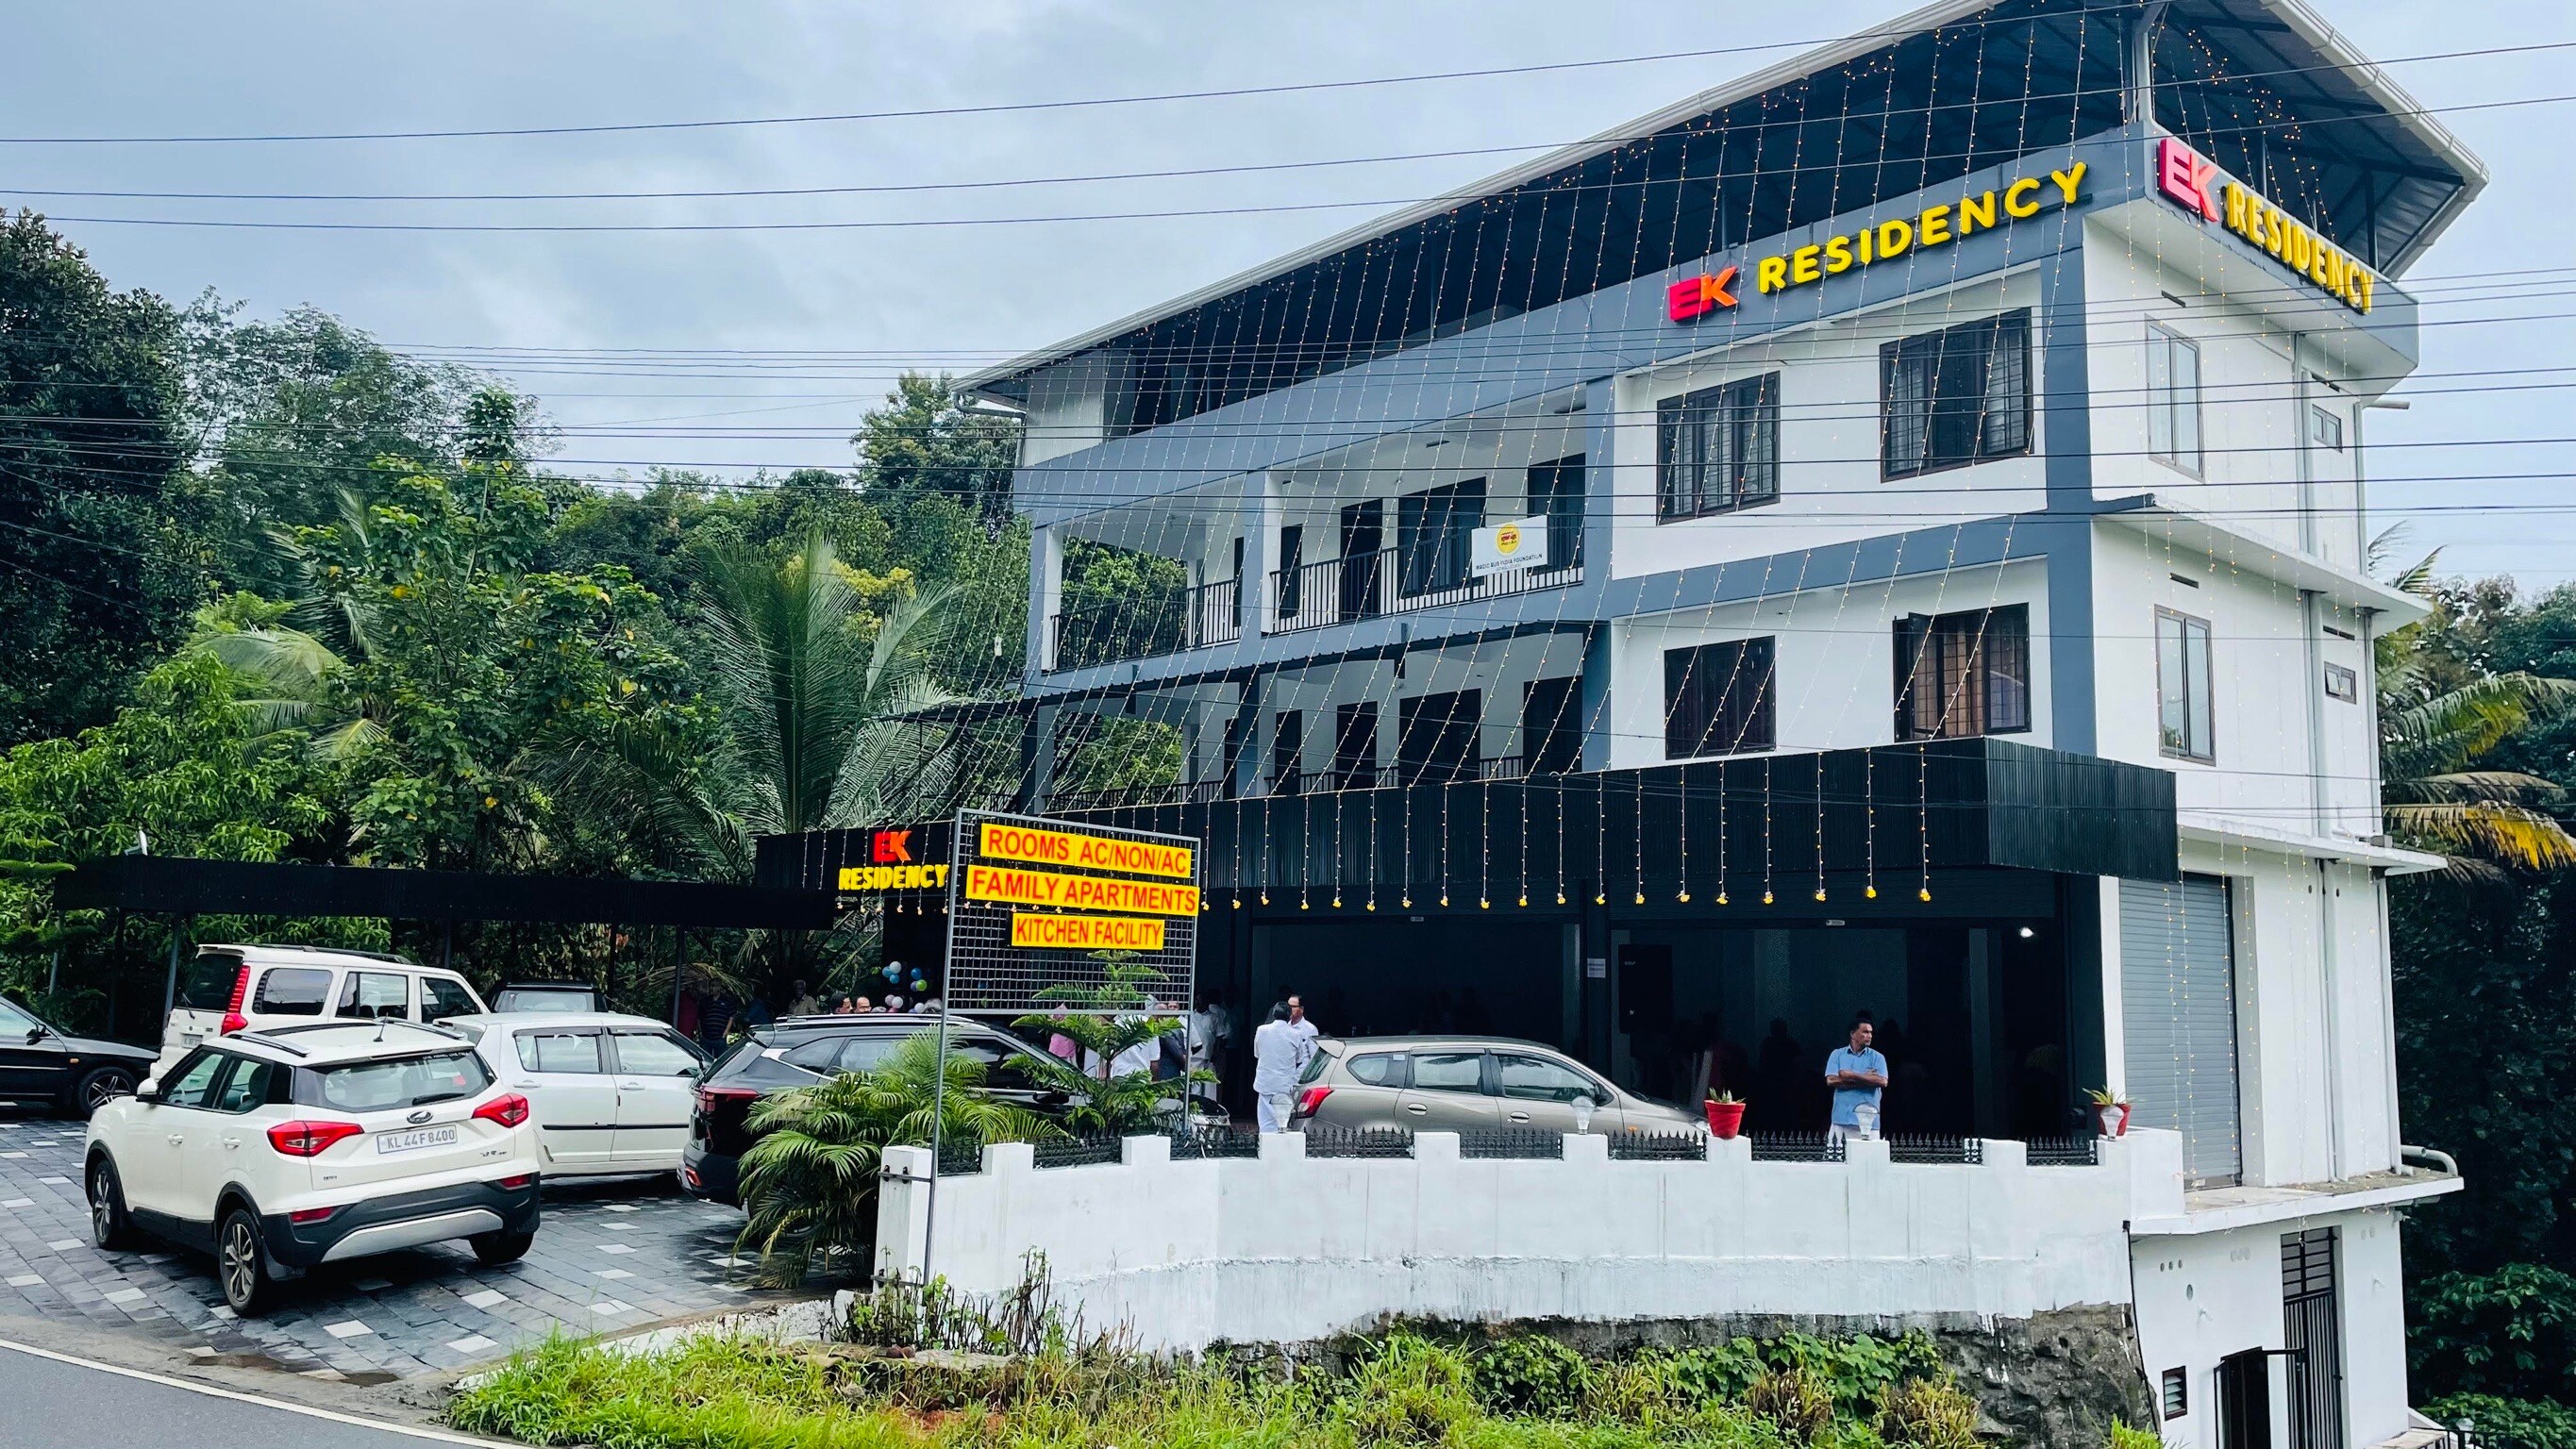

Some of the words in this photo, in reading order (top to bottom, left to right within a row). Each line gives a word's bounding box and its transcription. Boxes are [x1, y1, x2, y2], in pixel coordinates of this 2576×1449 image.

[1669, 266, 1739, 322] EK
[1758, 160, 2088, 294] RESIDENCY
[2159, 138, 2219, 223] EK
[2225, 180, 2375, 315] RESIDENCY
[873, 830, 912, 863] EK
[988, 828, 1069, 861] ROOMS
[1079, 840, 1187, 874] AC/NON/AC
[838, 863, 949, 891] RESIDENCY
[972, 869, 1060, 901] FAMILY
[1064, 879, 1196, 913] APARTMENTS
[1015, 917, 1089, 943] KITCHEN
[1095, 921, 1163, 945] FACILITY
[427, 1129, 455, 1143] 8400
